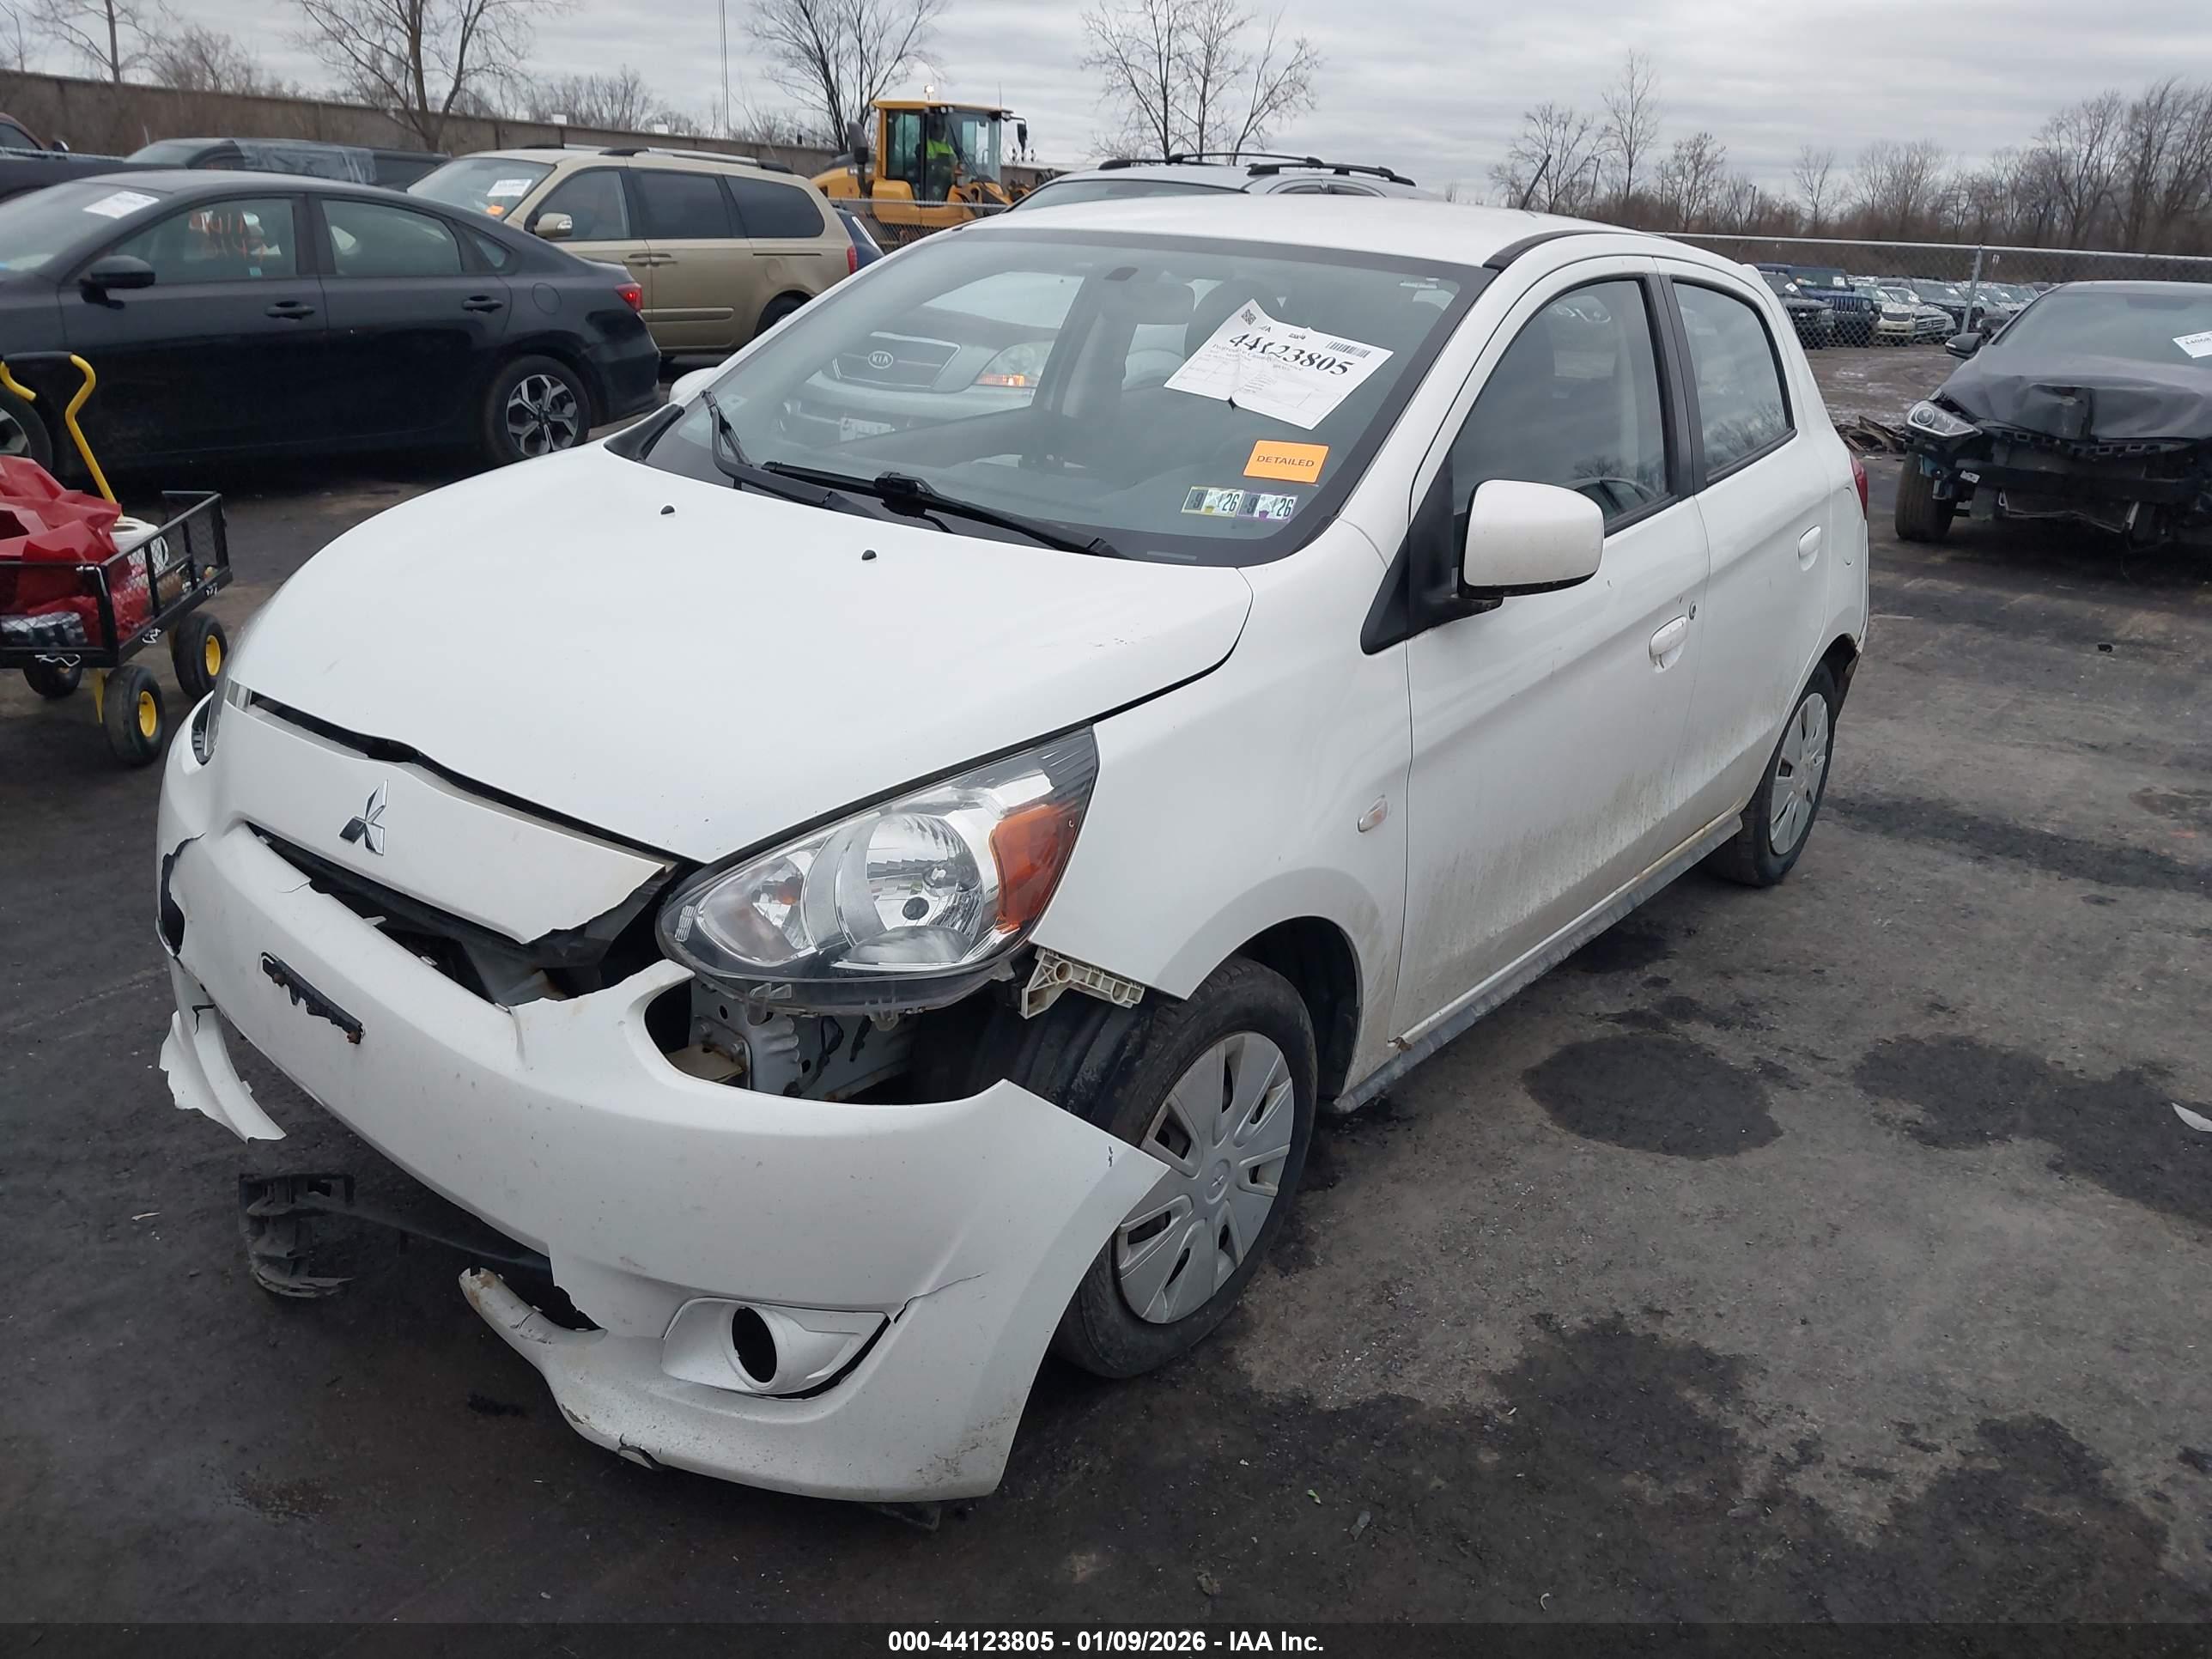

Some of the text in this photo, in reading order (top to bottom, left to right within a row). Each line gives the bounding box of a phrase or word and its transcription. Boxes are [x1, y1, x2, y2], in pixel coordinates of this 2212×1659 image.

[872, 354, 890, 364] KIA
[1256, 454, 1315, 468] DETAILED
[1222, 493, 1240, 512] 26
[1276, 497, 1295, 517] 26
